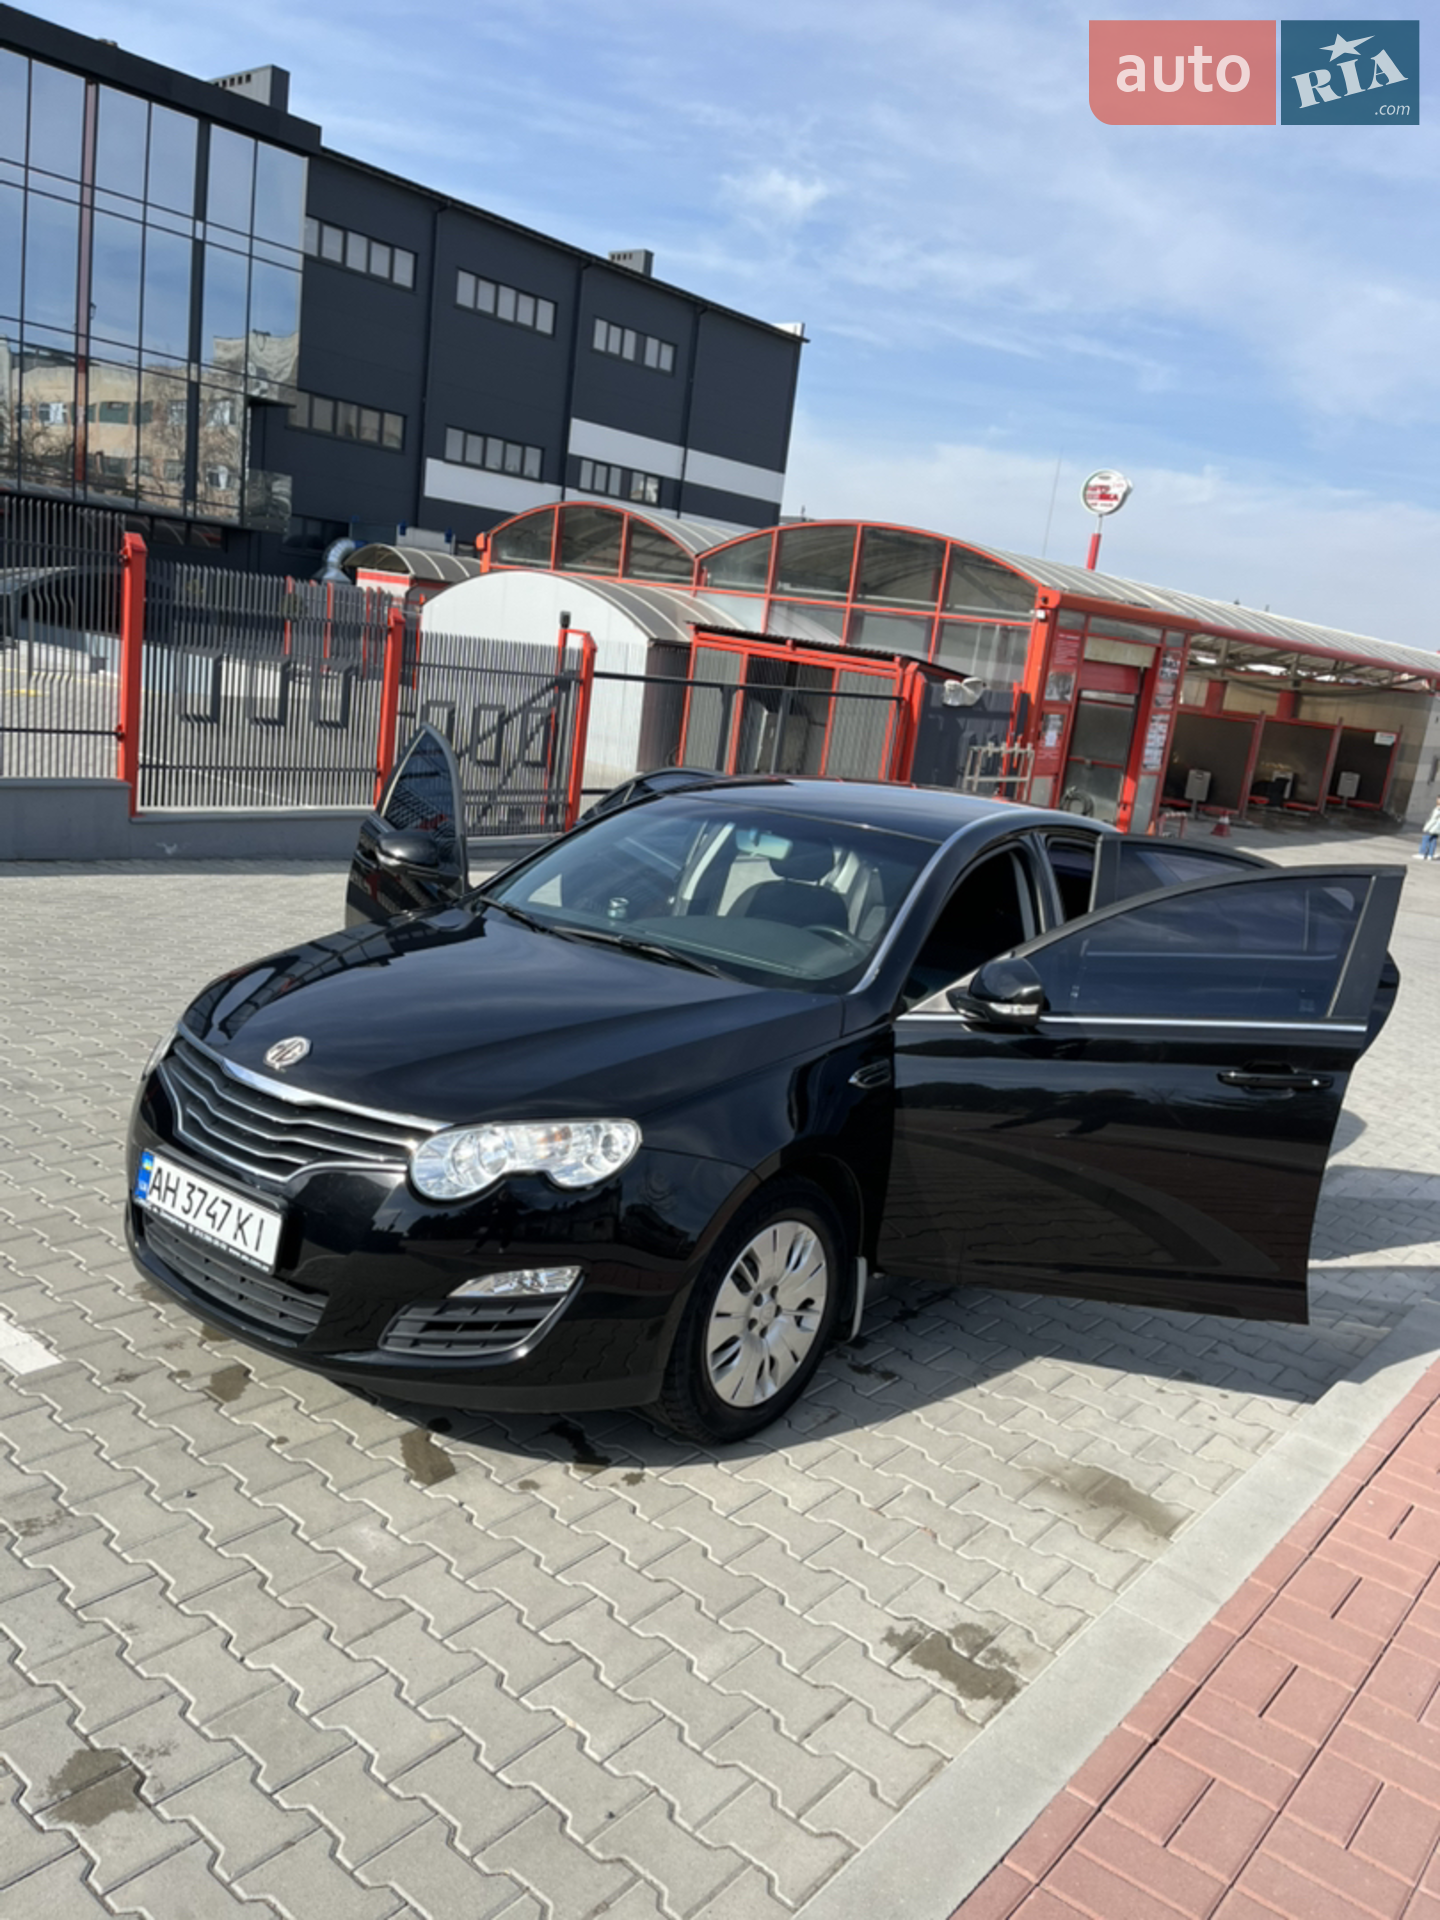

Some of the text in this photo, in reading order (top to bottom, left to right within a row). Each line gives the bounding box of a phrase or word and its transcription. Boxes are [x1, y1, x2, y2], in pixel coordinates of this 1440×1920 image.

[149, 1166, 181, 1208] AH
[181, 1181, 233, 1233] 3747
[233, 1207, 265, 1252] KI
